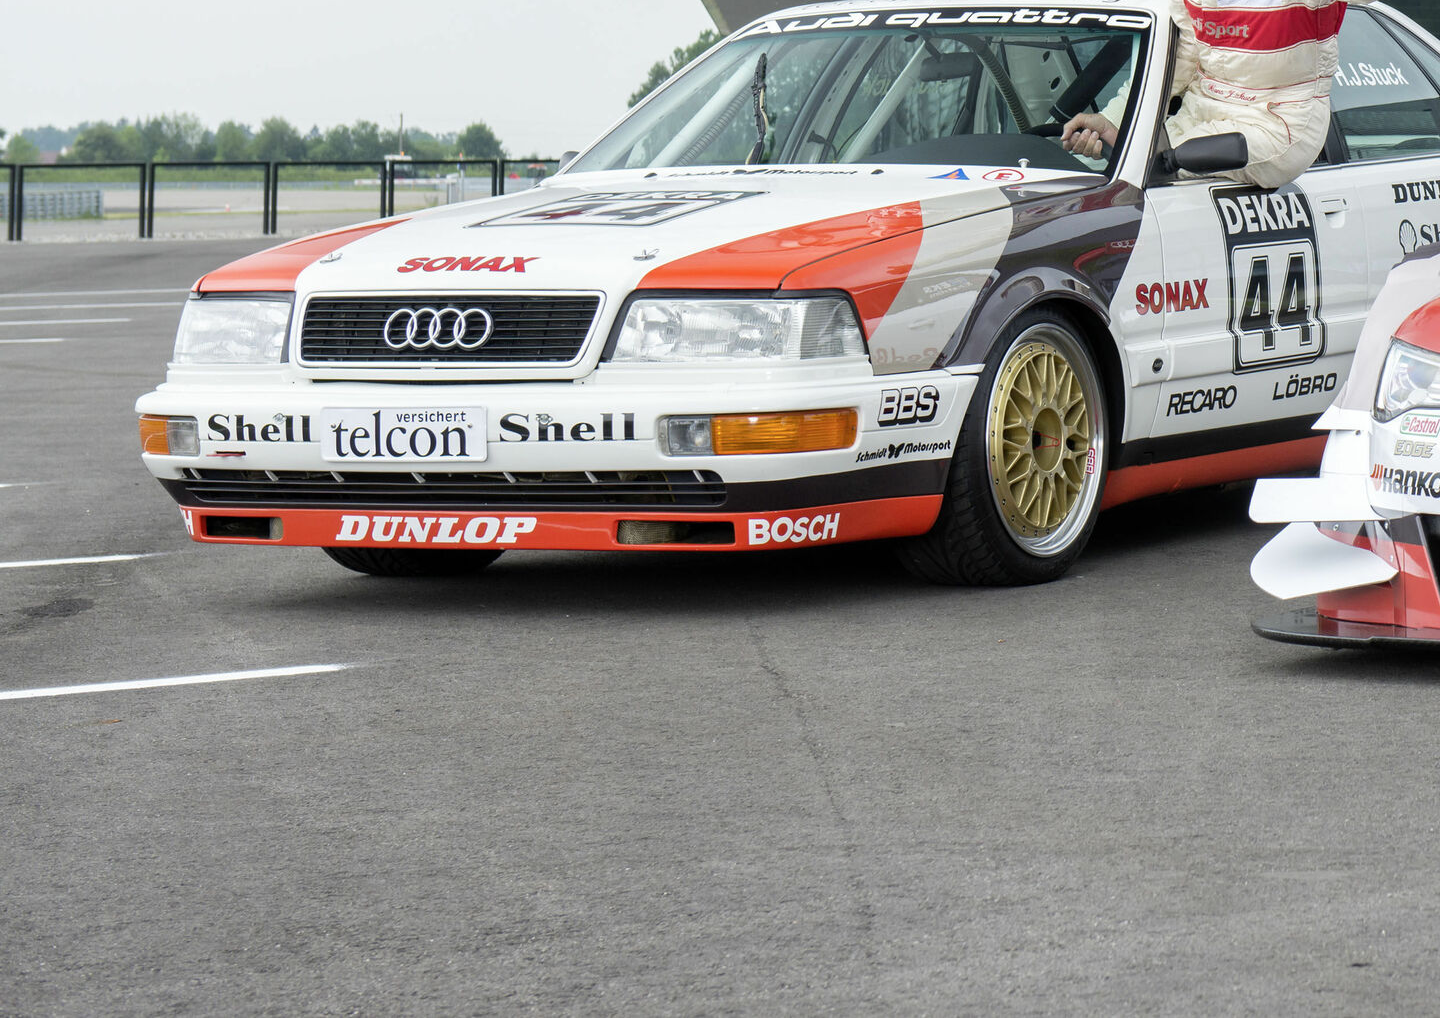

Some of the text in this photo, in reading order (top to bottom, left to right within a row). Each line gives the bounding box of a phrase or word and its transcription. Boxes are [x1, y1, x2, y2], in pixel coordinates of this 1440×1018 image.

[731, 8, 1152, 36] Audi quattro
[1204, 22, 1250, 38] Sport
[1217, 192, 1311, 235] DEKRA
[397, 256, 540, 274] SONAX
[1135, 278, 1210, 315] SONAX
[1237, 252, 1312, 352] 44
[1167, 384, 1238, 417] RECARO
[1273, 372, 1338, 401] LÖBRO
[396, 410, 467, 423] versichert
[877, 384, 940, 427] BBS
[207, 413, 312, 442] Shell
[334, 409, 469, 458] telcon
[499, 412, 638, 442] Shell
[1408, 416, 1440, 434] Castrol
[855, 439, 952, 464] Schmidt Motorsport
[1393, 439, 1437, 458] EDGE
[335, 514, 538, 544] DUNLOP
[748, 513, 841, 545] BOSCH
